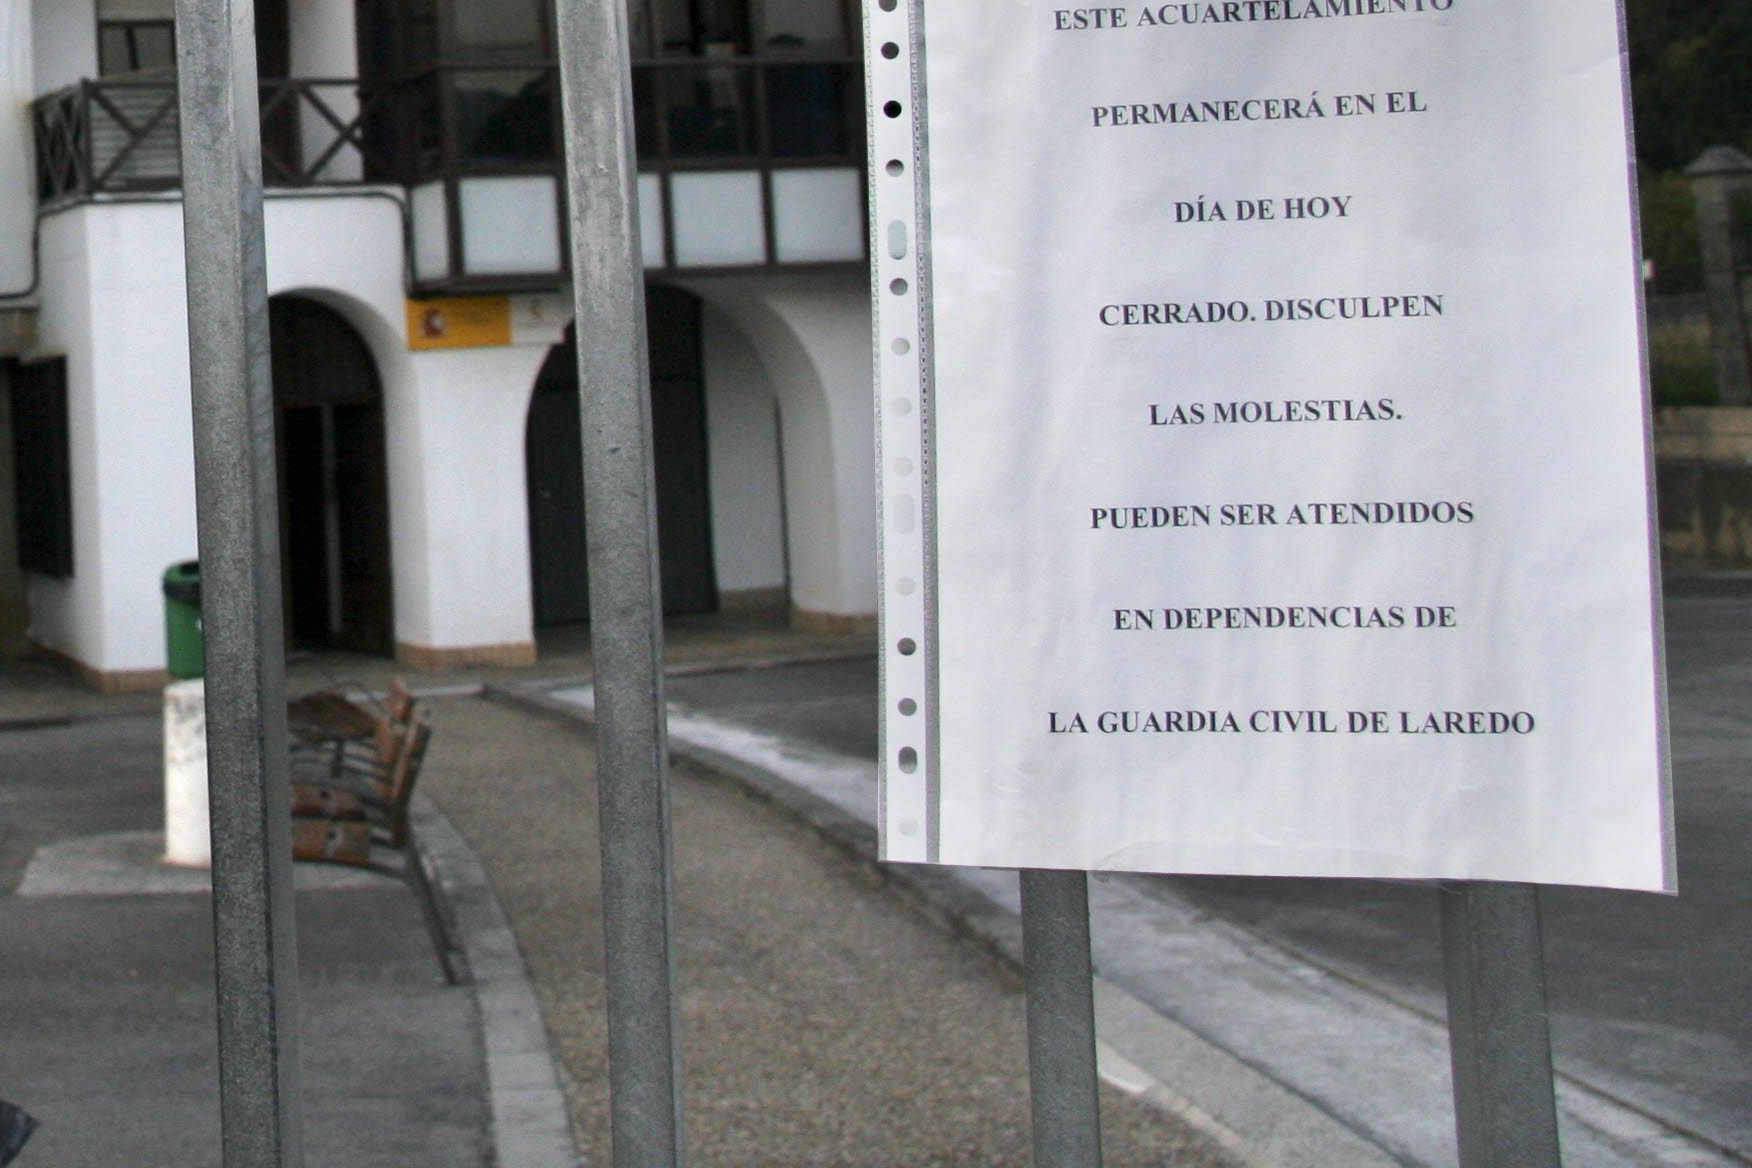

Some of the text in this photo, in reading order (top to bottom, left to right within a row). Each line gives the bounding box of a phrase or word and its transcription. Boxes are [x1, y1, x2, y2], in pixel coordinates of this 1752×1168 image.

[1054, 7, 1127, 31] ESTE
[1091, 91, 1427, 127] PERMANECERÁ EN EL
[1174, 195, 1352, 223] DÍA DE HOY
[1099, 294, 1444, 326] CERRADO. DISCULPEN
[1149, 398, 1402, 426] LAS MOLESTIAS.
[1090, 501, 1474, 529] PUEDEN SER ATENDIDOS
[1113, 605, 1457, 631] EN DEPENDENCIAS DE
[1048, 709, 1535, 735] LA GUARDIA CIVIL DE LAREDO
